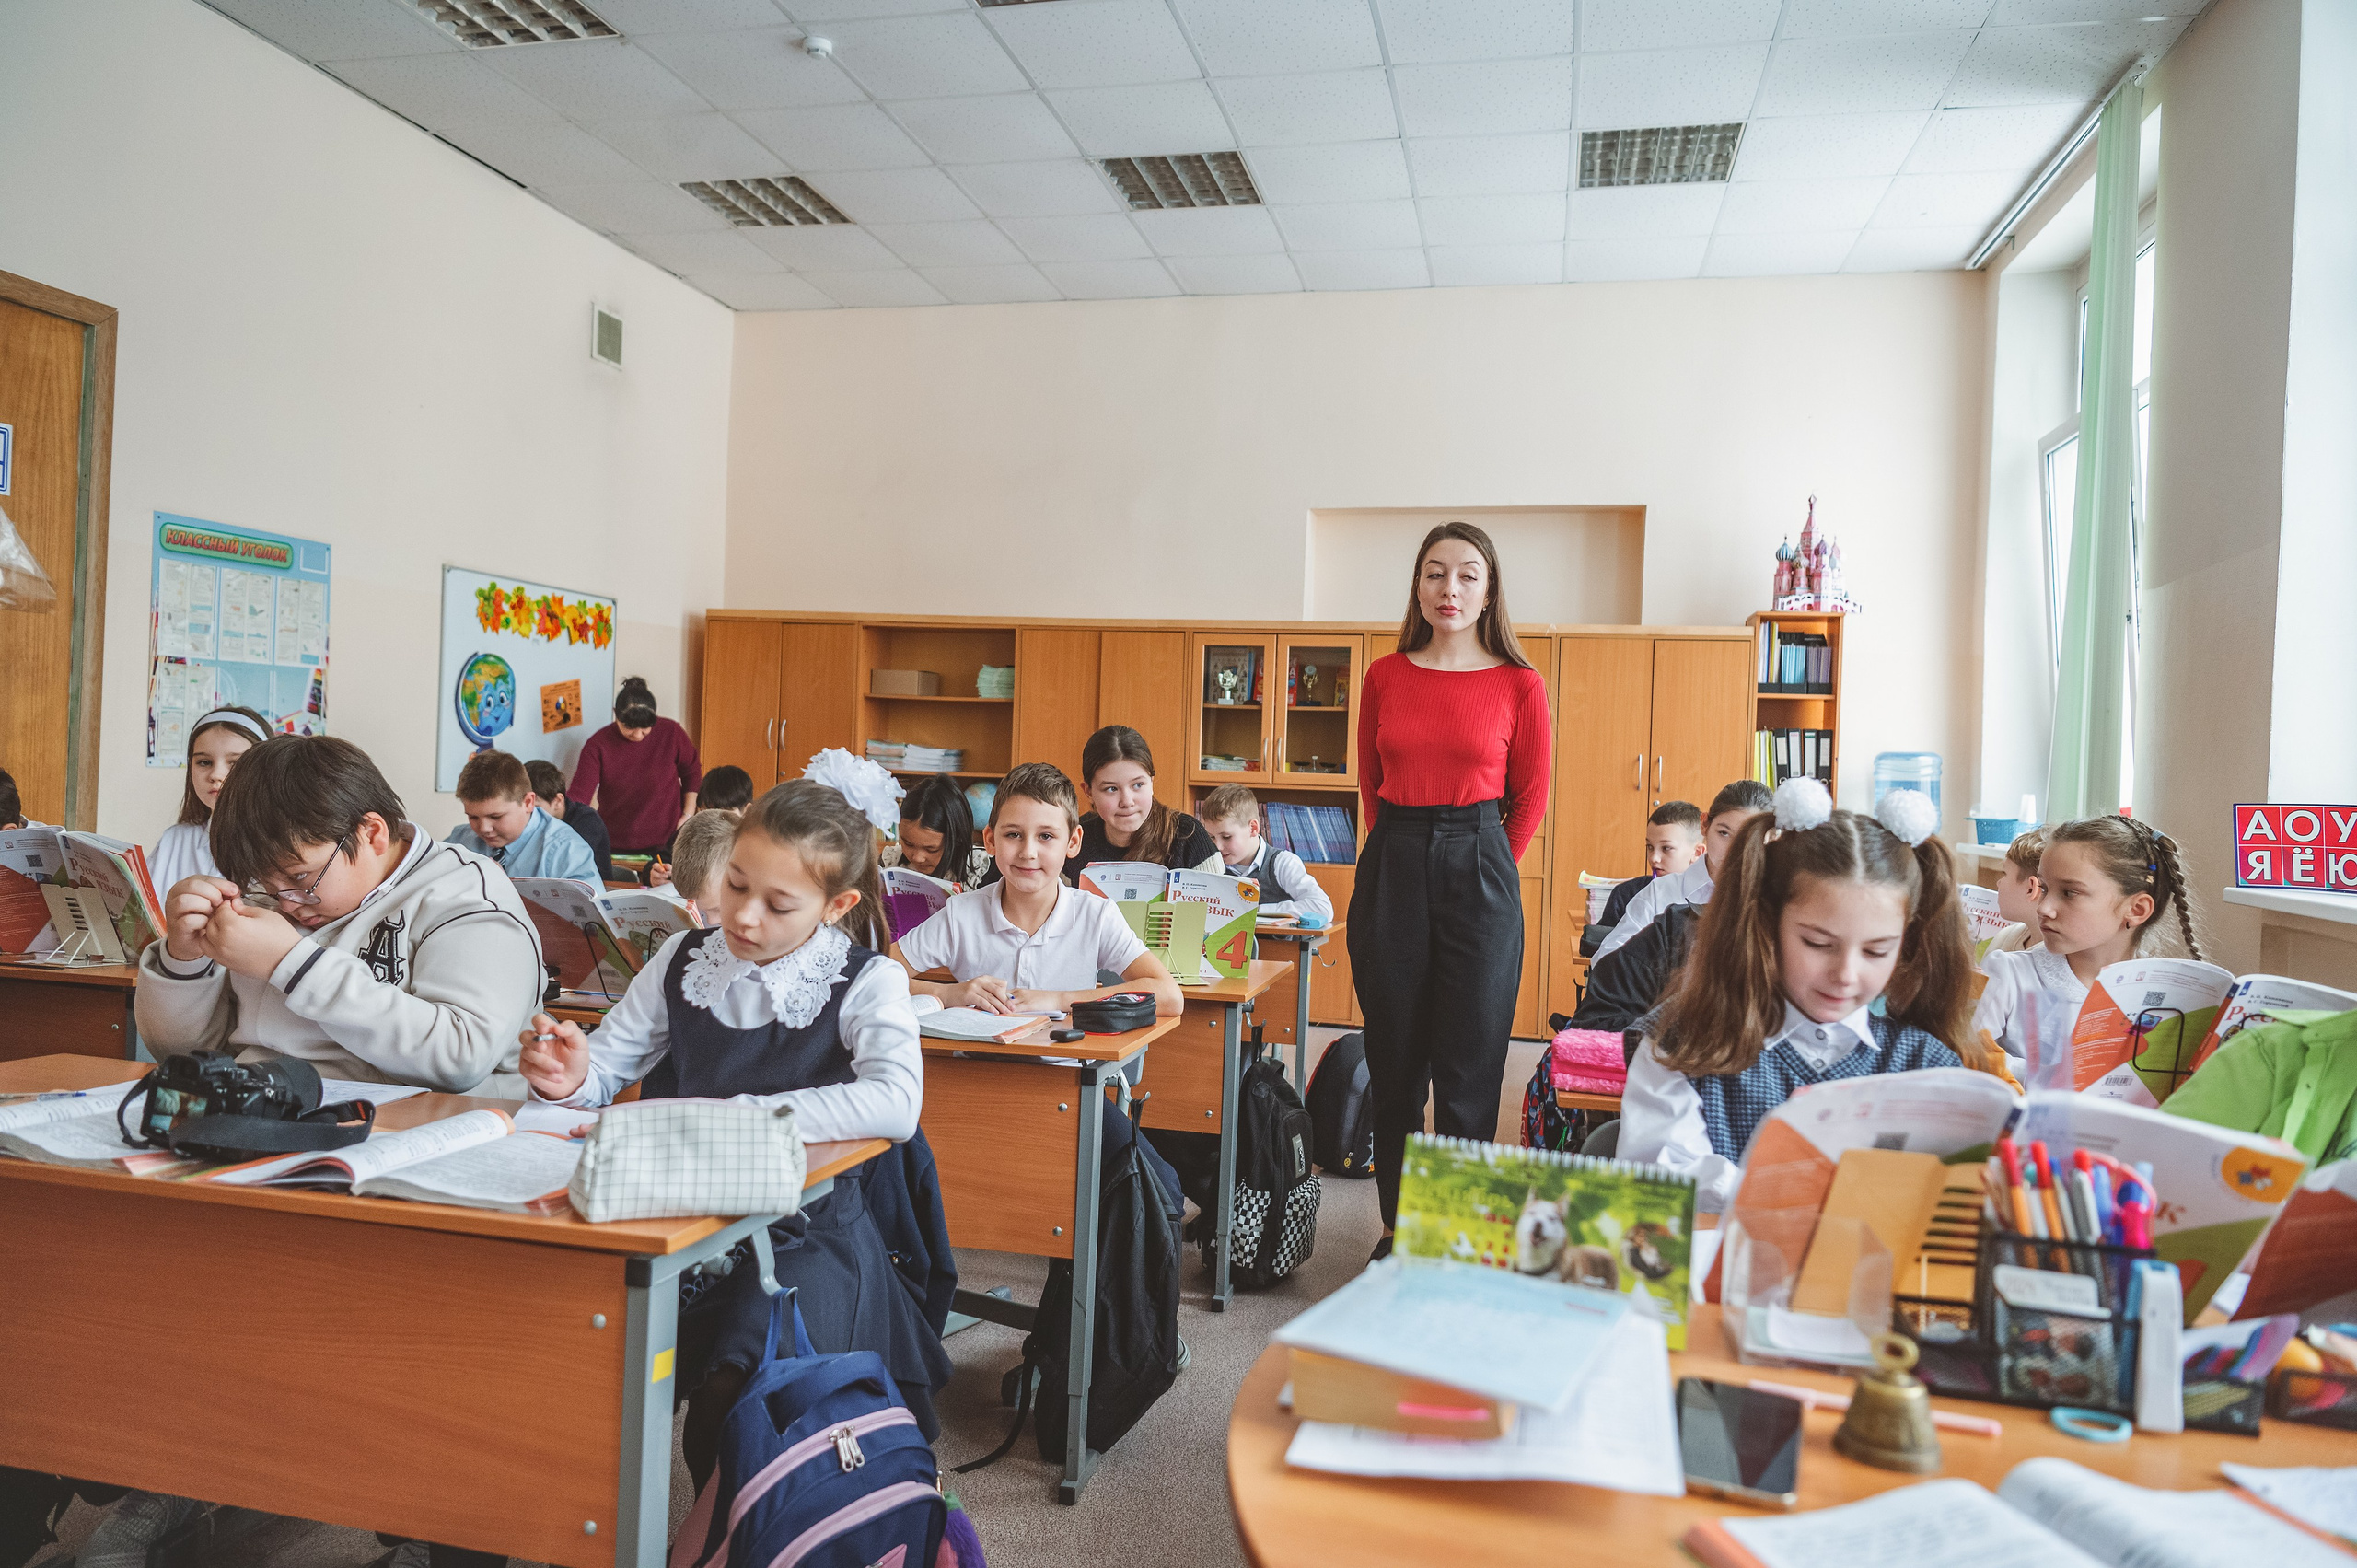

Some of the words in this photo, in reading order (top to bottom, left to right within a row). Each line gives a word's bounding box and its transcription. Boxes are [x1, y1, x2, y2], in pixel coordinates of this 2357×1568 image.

[166, 528, 239, 554] КЛАССНЫЙ
[241, 540, 289, 563] УГОЛОК
[2241, 809, 2277, 841] А
[2284, 809, 2321, 842] О
[2329, 811, 2357, 843] У
[2247, 850, 2272, 881] Я
[2292, 846, 2316, 883] Ё
[2328, 853, 2357, 887] Ю
[1172, 889, 1221, 905] Русский
[1207, 905, 1235, 918] зык
[611, 916, 672, 930] Русский
[1216, 930, 1248, 969] 4
